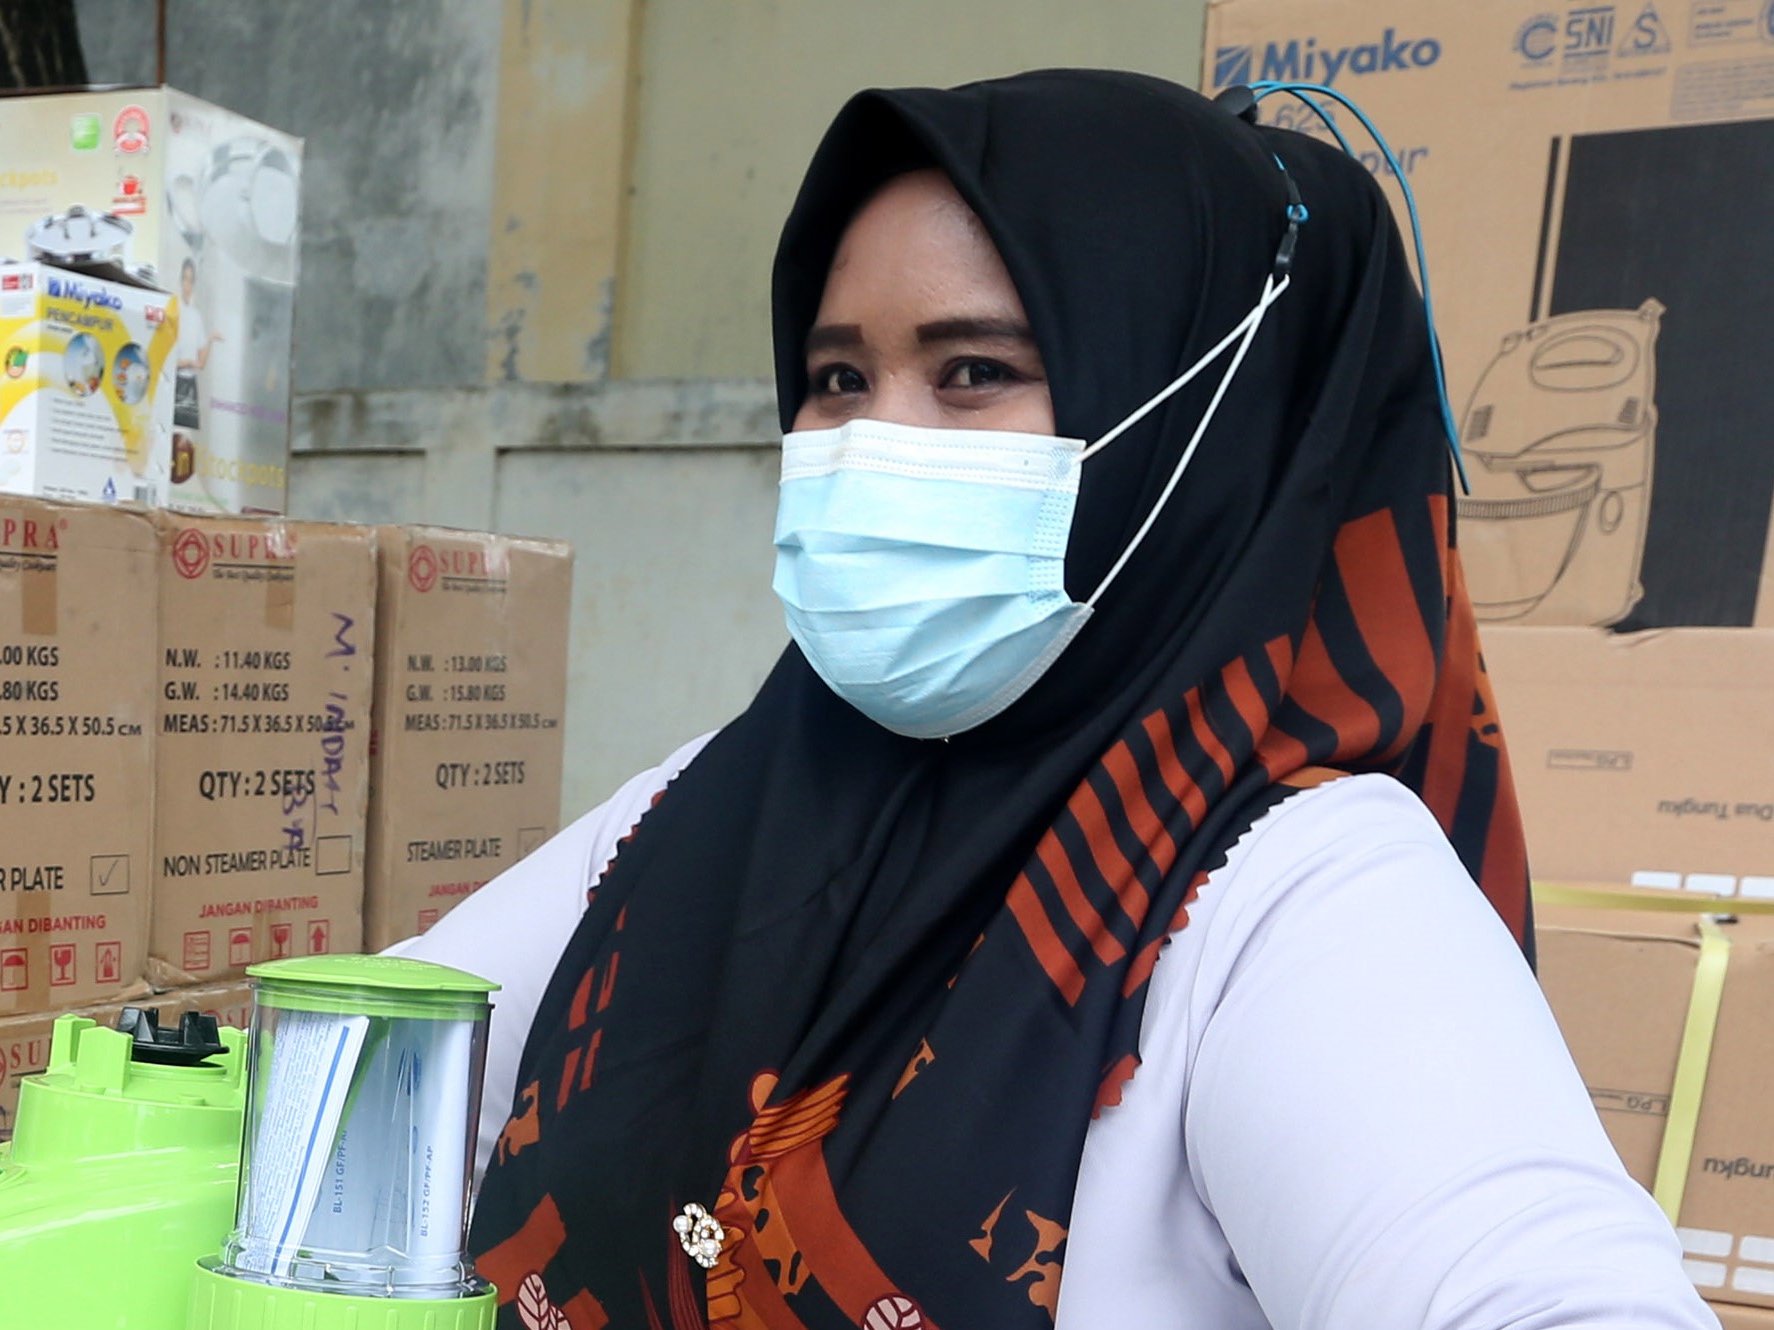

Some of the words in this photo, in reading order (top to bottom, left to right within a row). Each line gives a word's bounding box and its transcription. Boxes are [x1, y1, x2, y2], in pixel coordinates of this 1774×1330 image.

[1565, 14, 1615, 51] SNI
[1260, 28, 1442, 87] Miyako
[62, 280, 123, 310] Miyako
[45, 307, 114, 331] PENCAMPUR
[26, 646, 59, 667] KGS
[166, 648, 201, 668] N.W.
[224, 651, 261, 669] 11.40
[264, 652, 291, 670] KGS
[484, 656, 507, 672] KGS
[26, 681, 59, 701] KGS
[164, 681, 200, 700] G.W.
[223, 683, 260, 701] 14.40
[263, 683, 289, 702] KGS
[484, 684, 506, 701] KGS
[31, 716, 64, 736] 36.5
[83, 716, 115, 736] 50.5
[163, 714, 209, 733] MEAS
[221, 715, 249, 733] 71.5
[265, 715, 293, 733] 36.5
[405, 714, 440, 731] MEAS
[449, 713, 473, 731] 71.5
[199, 771, 242, 800] QTY
[254, 771, 265, 796] 2
[271, 770, 316, 796] SETS
[436, 763, 470, 789] QTY
[483, 763, 491, 786] 2
[494, 761, 525, 785] SETS
[31, 775, 43, 803] 2
[48, 774, 95, 802] SETS
[1657, 798, 1729, 820] Tungku
[407, 840, 461, 862] STEAMER
[465, 838, 501, 859] PLATE
[163, 855, 201, 878] NON
[205, 850, 267, 875] STEAMER
[270, 847, 311, 869] PLATE
[11, 866, 64, 891] PLATE
[199, 900, 252, 919] JANGAN
[254, 896, 319, 914] DIBANTING
[28, 914, 106, 933] DIBANTING
[332, 1179, 344, 1214] BL-151
[420, 1200, 431, 1237] BL-152
